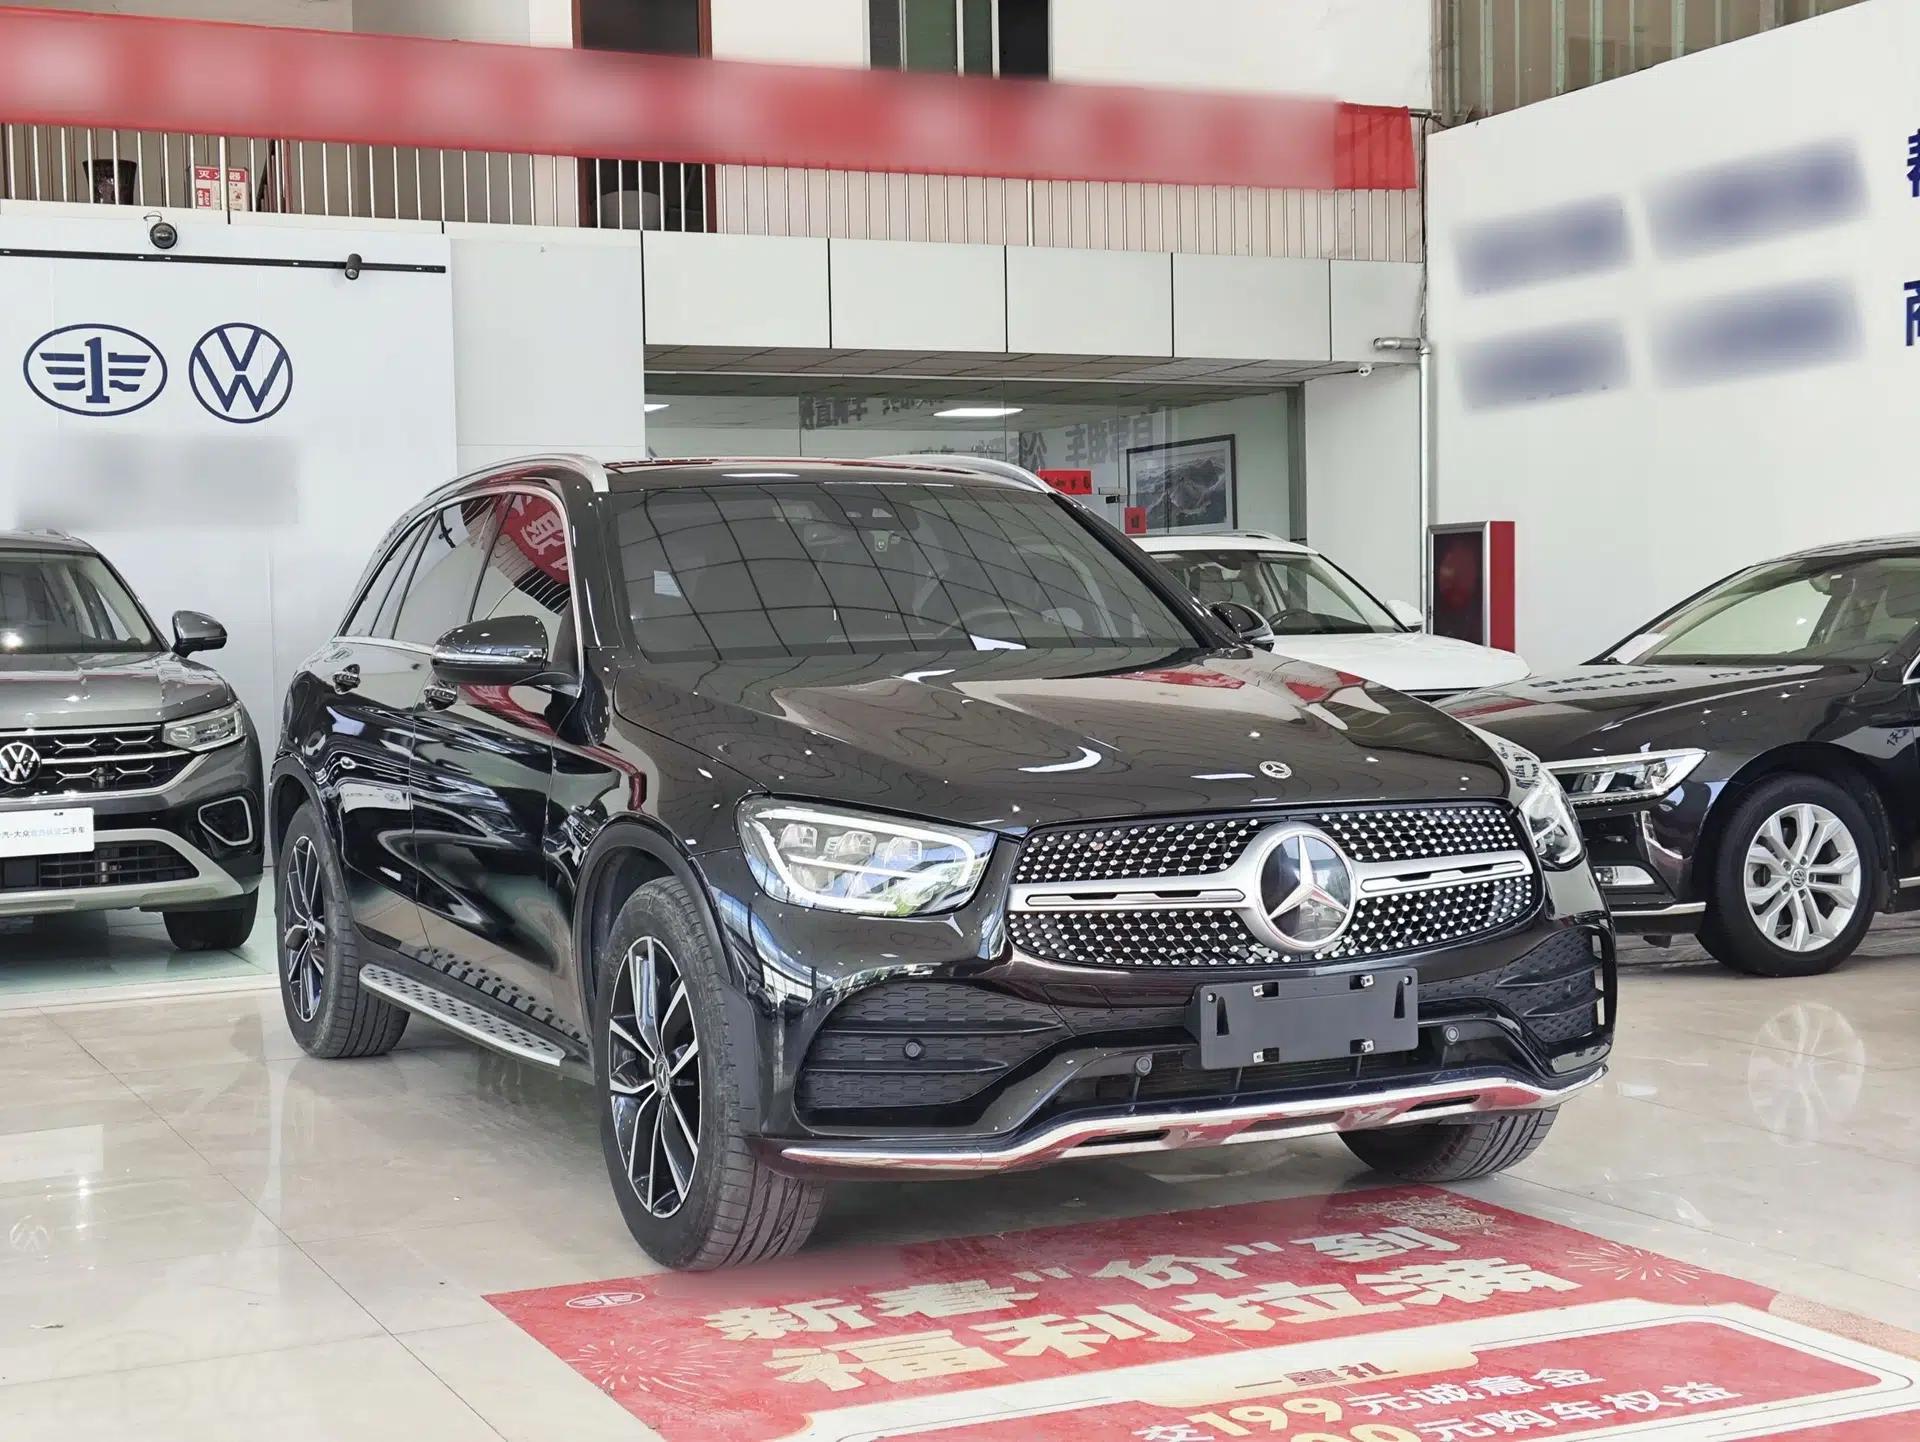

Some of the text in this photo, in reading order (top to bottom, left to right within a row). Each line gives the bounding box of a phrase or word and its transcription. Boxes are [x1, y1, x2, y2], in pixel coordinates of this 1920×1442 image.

[190, 324, 292, 422] VW
[762, 1257, 1584, 1392] 福利拉满
[1234, 1361, 1399, 1388] 一重礼
